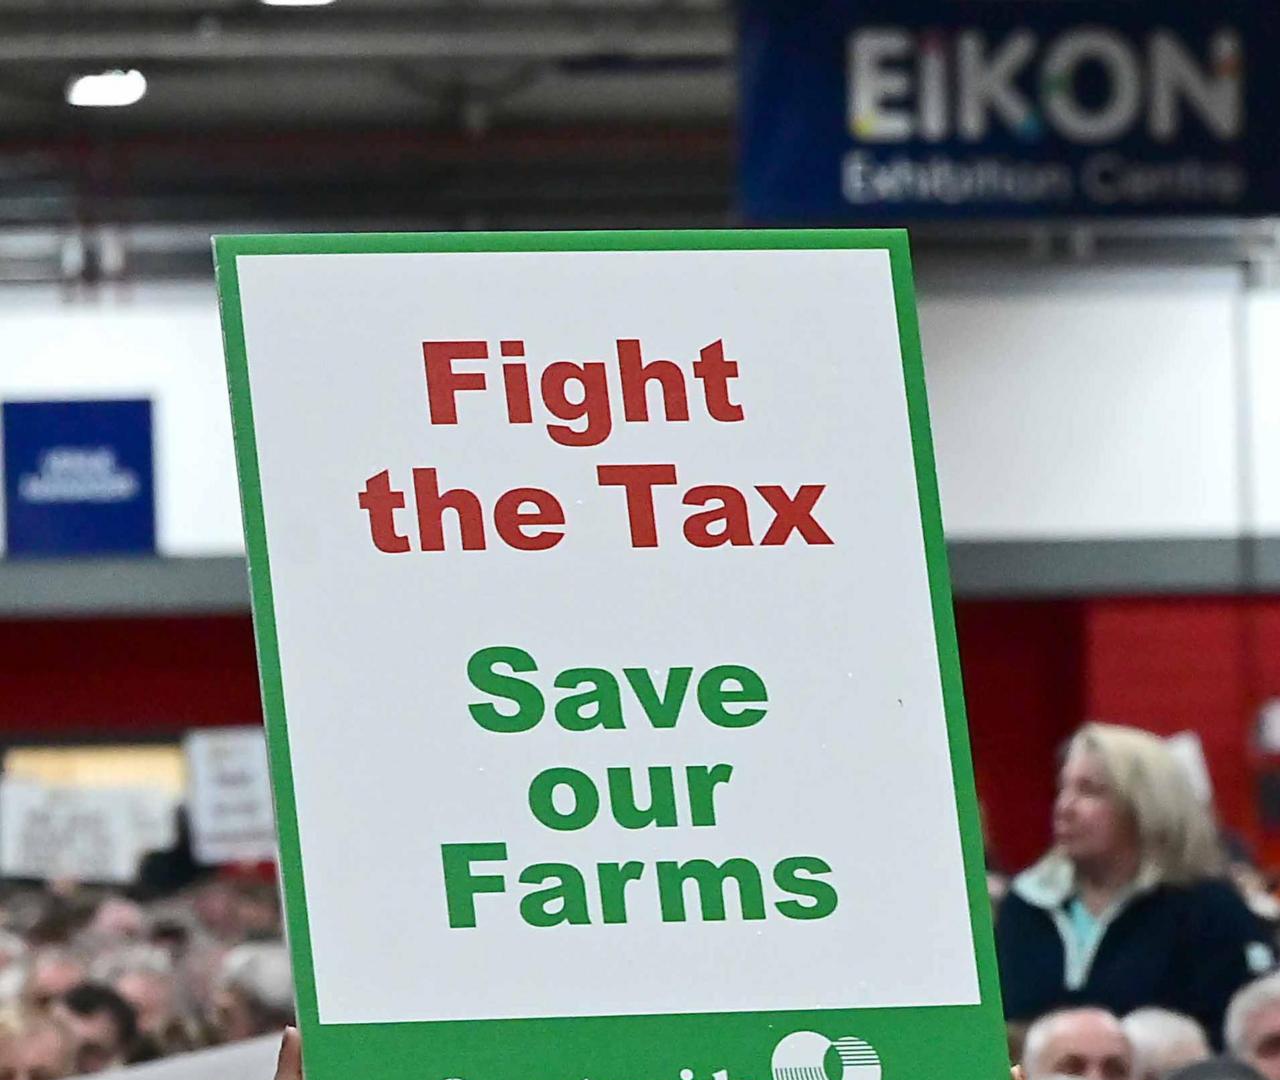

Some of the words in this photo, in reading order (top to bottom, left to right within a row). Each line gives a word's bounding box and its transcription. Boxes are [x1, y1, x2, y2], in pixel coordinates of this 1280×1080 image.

[850, 27, 1243, 144] EIKON
[423, 340, 744, 446] Fight
[359, 468, 565, 553] the
[597, 465, 833, 547] Tax
[468, 647, 767, 732] Save
[529, 764, 733, 831] our
[442, 843, 837, 928] Farms
